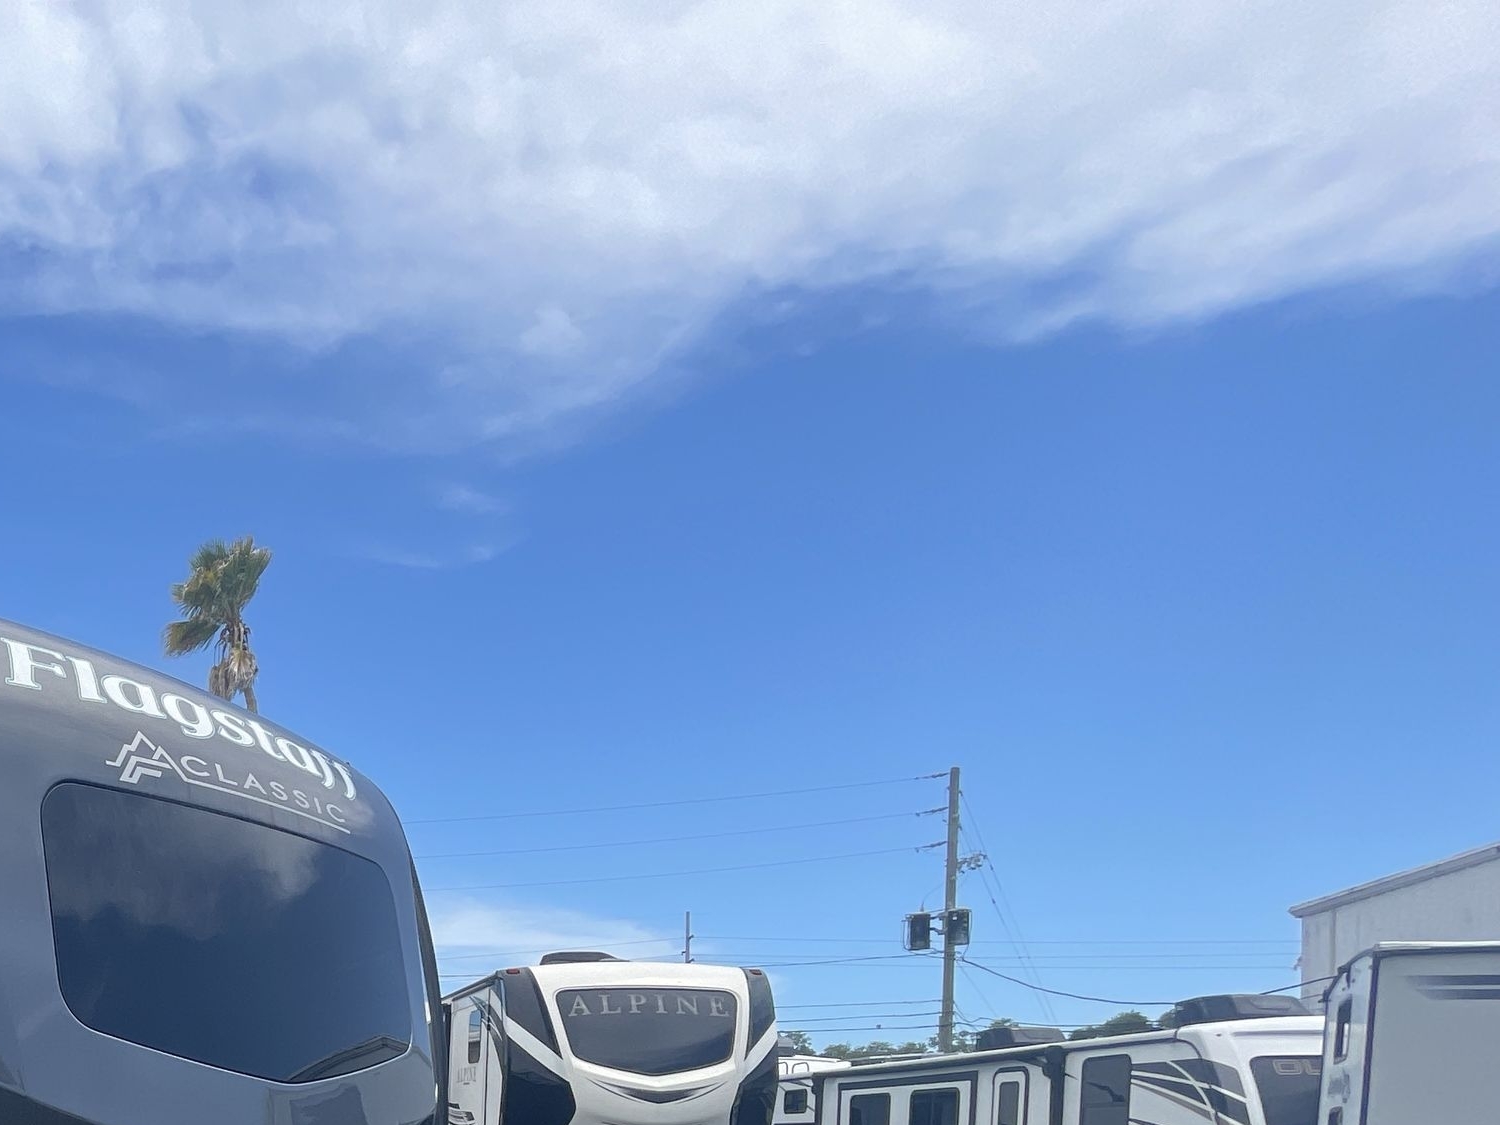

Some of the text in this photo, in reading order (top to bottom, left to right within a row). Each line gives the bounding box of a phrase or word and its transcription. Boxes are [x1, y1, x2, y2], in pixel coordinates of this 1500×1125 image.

[0, 637, 357, 802] Flagstaff
[180, 755, 346, 824] CLASSIC
[568, 993, 730, 1017] ALPINE
